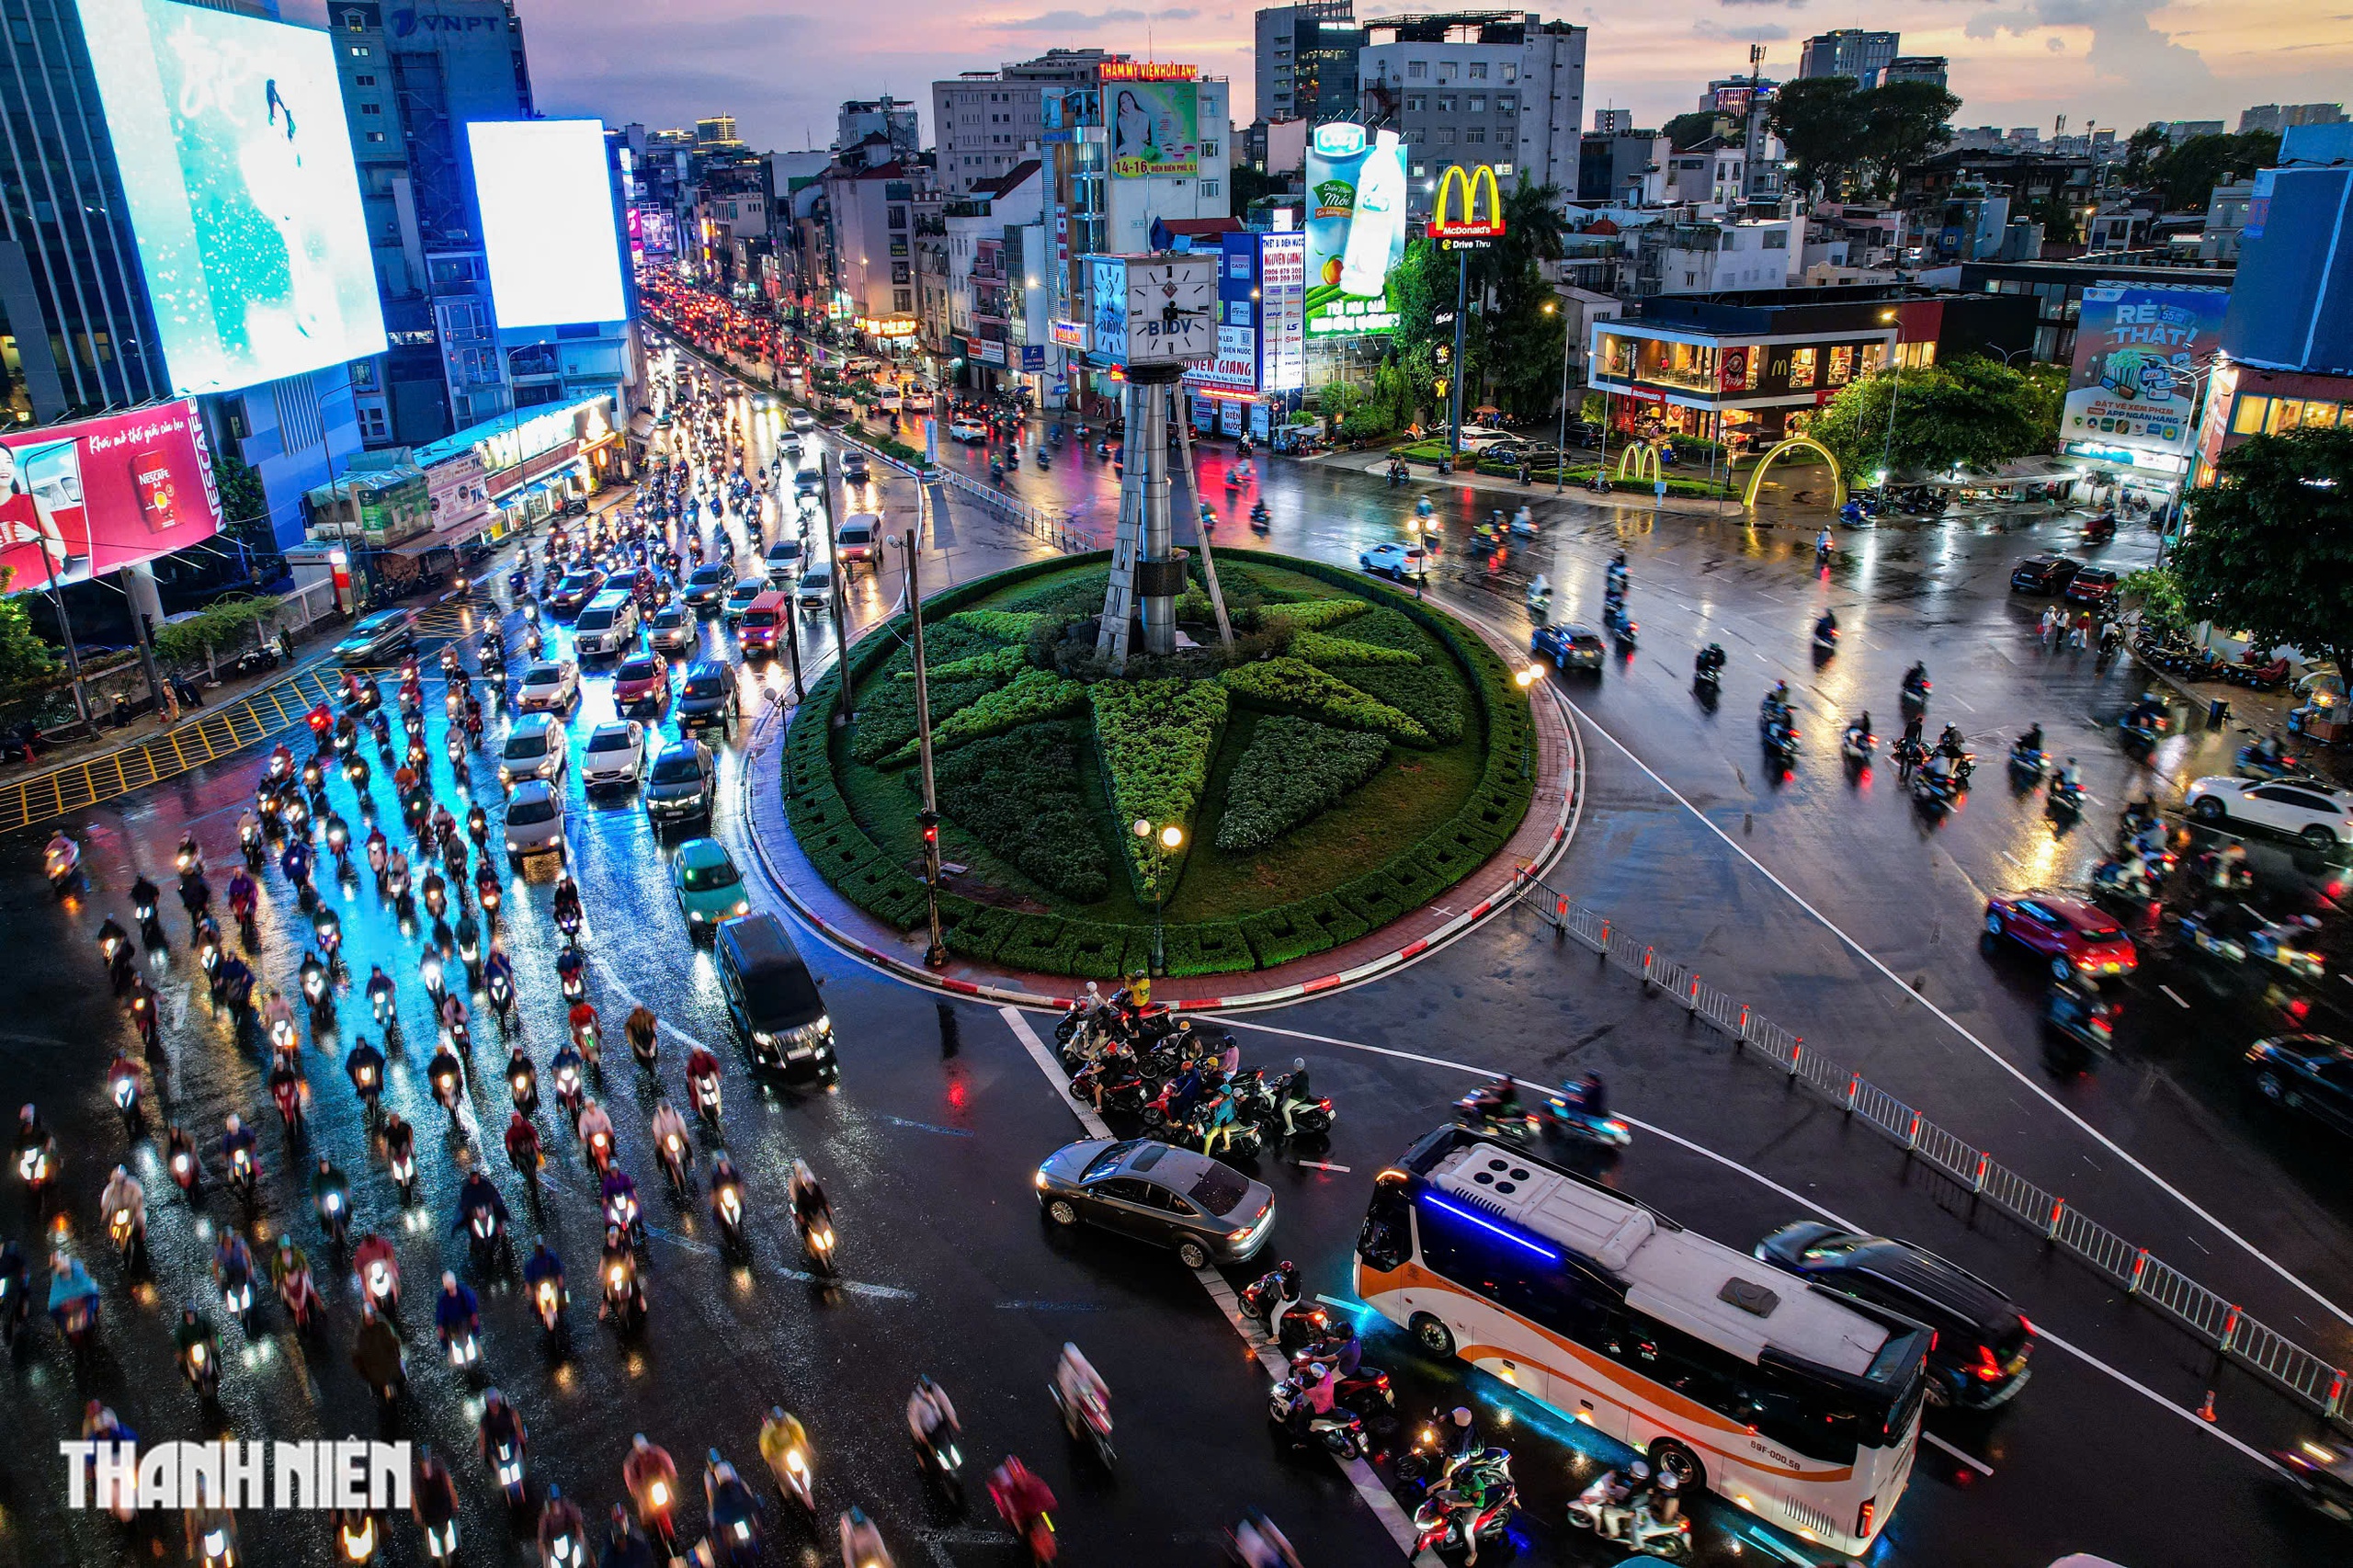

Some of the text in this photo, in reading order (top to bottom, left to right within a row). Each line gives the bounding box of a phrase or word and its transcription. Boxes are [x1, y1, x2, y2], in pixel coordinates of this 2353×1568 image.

[422, 16, 498, 31] VNPT
[1181, 64, 1198, 79] ANH
[1115, 161, 1148, 173] 14-16
[1324, 192, 1351, 207] Mới
[1443, 225, 1491, 235] McDonald's
[1453, 240, 1491, 248] Drive Thru
[2116, 299, 2158, 324] RẺ
[1148, 319, 1192, 335] BIDV
[1287, 322, 1299, 331] LS
[1219, 359, 1251, 377] GIANG
[1225, 411, 1241, 421] ĐIỆN
[2128, 403, 2147, 412] XEM
[2148, 406, 2174, 415] PHIM
[471, 457, 483, 472] 7K
[471, 485, 484, 505] 7K
